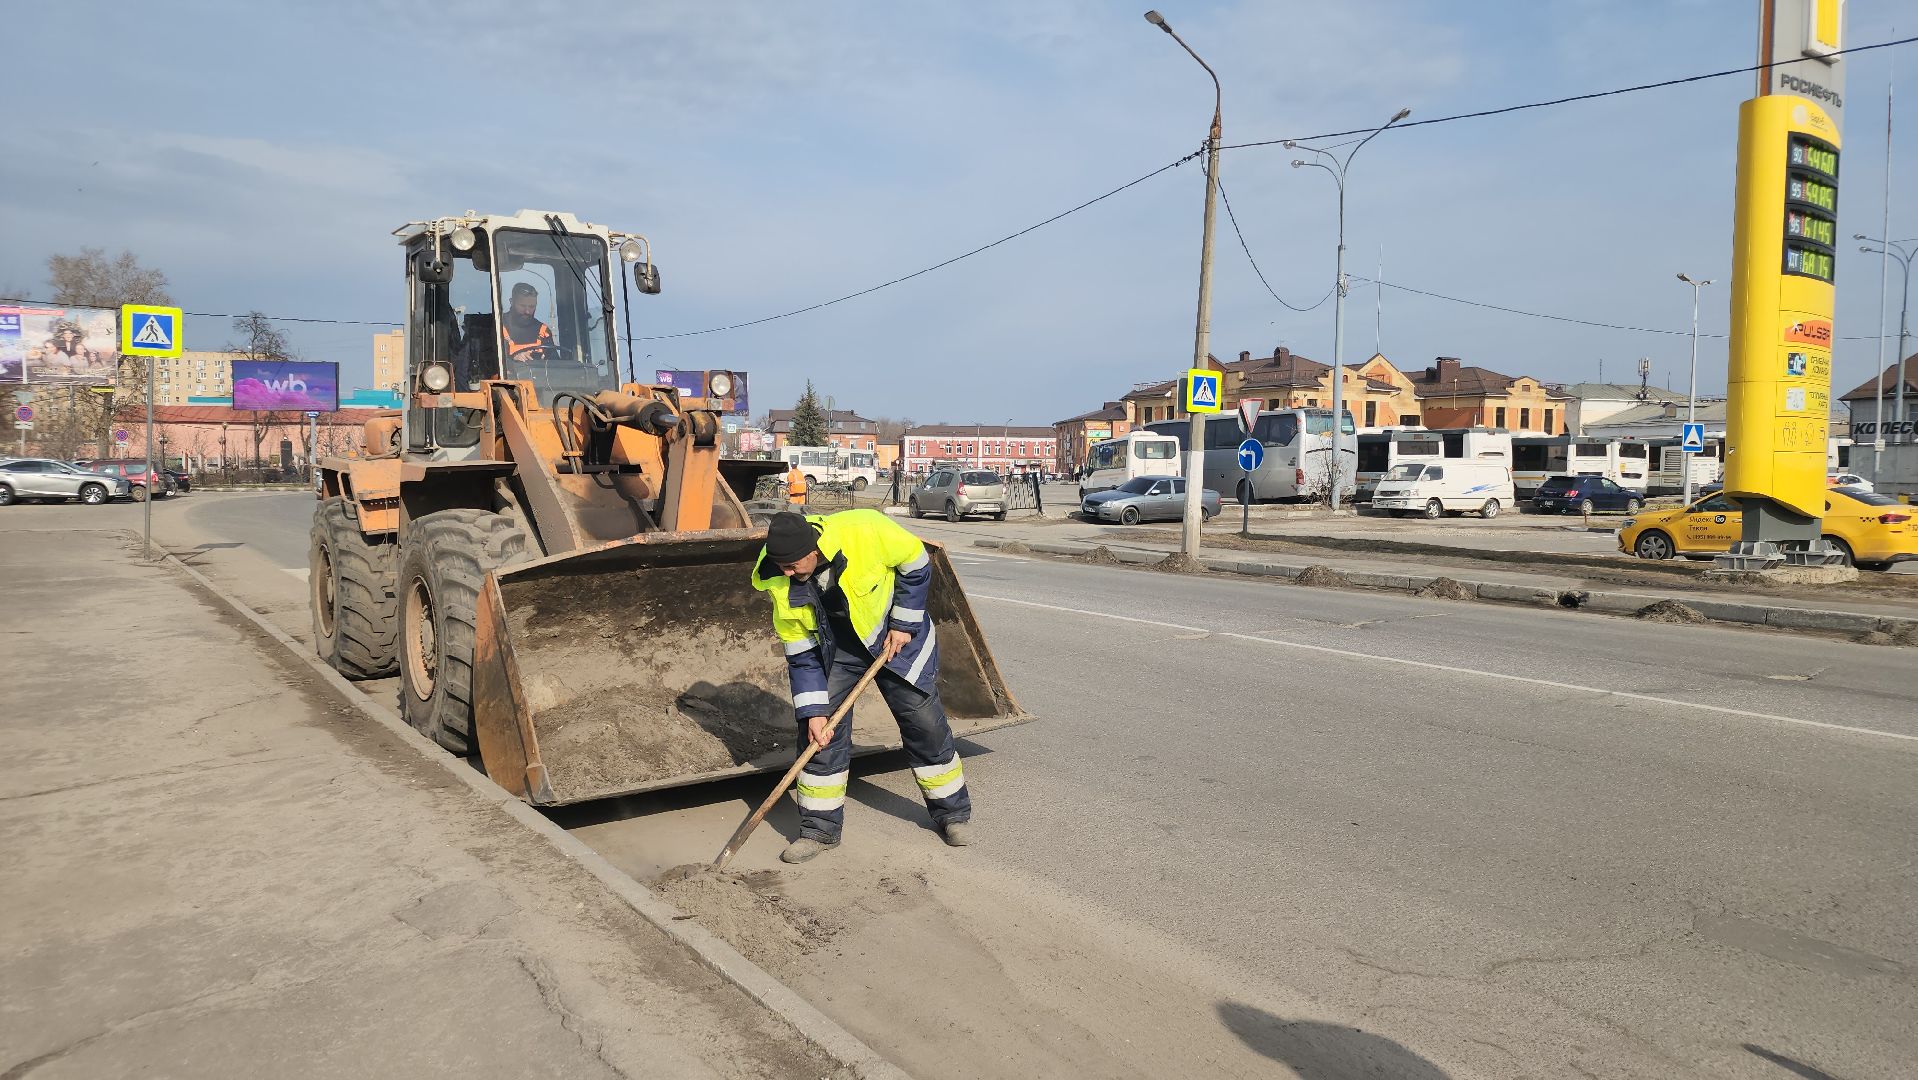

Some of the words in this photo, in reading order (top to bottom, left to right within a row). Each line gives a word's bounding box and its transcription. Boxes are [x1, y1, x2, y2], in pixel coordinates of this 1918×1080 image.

[1781, 73, 1842, 107] РОСНЕФТЬ
[1791, 182, 1801, 198] 95
[1788, 252, 1800, 269] ДТ
[264, 373, 307, 394] wb
